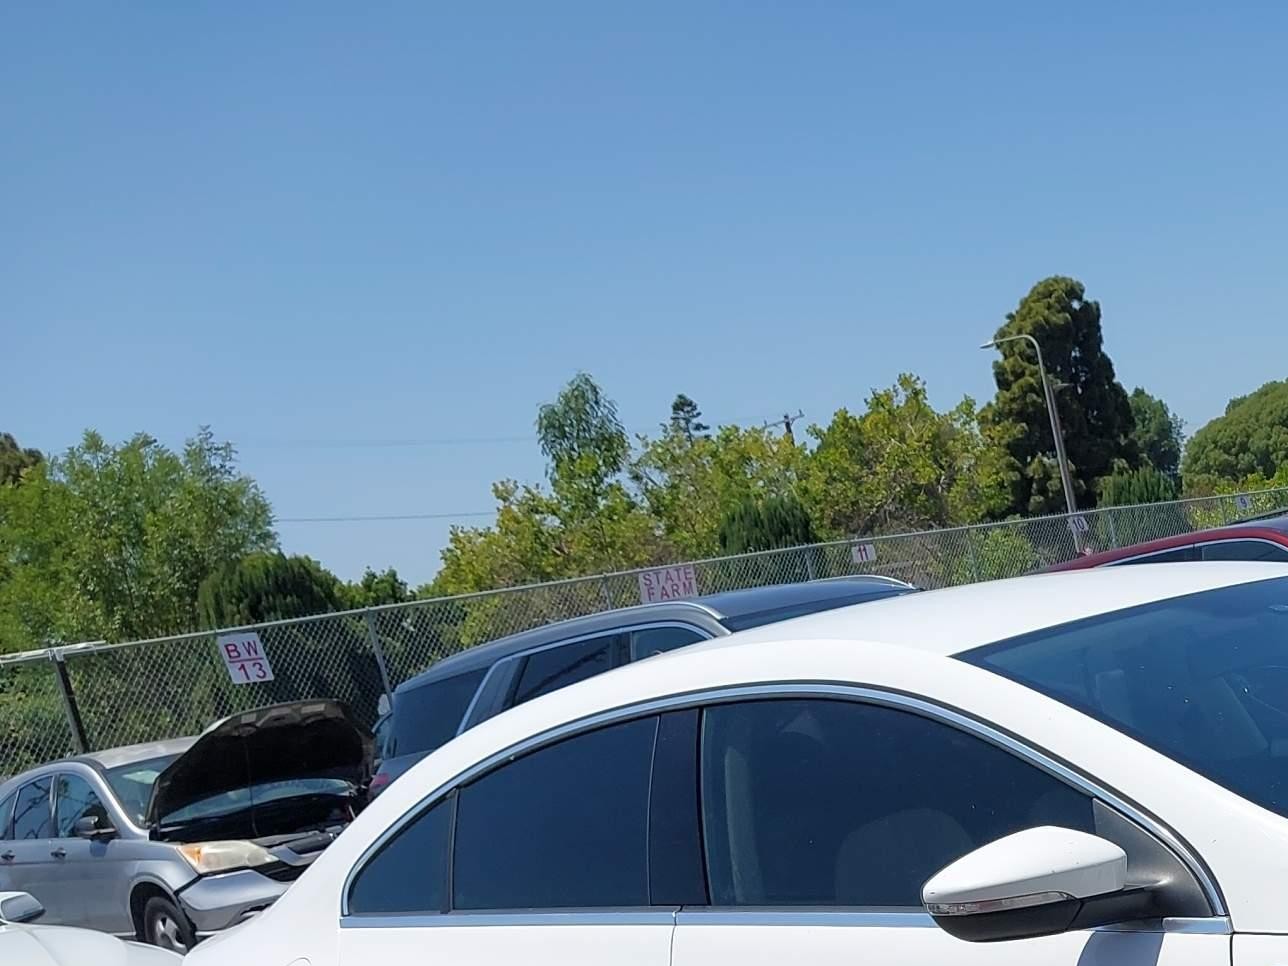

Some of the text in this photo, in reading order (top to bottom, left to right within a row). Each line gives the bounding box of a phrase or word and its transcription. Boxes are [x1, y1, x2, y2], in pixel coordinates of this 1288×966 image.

[1240, 497, 1247, 507] 9
[1072, 518, 1085, 531] 10
[858, 545, 869, 561] 11
[643, 566, 693, 587] STATE
[647, 581, 694, 602] FARM
[224, 640, 258, 659] BW
[238, 662, 267, 681] 13
